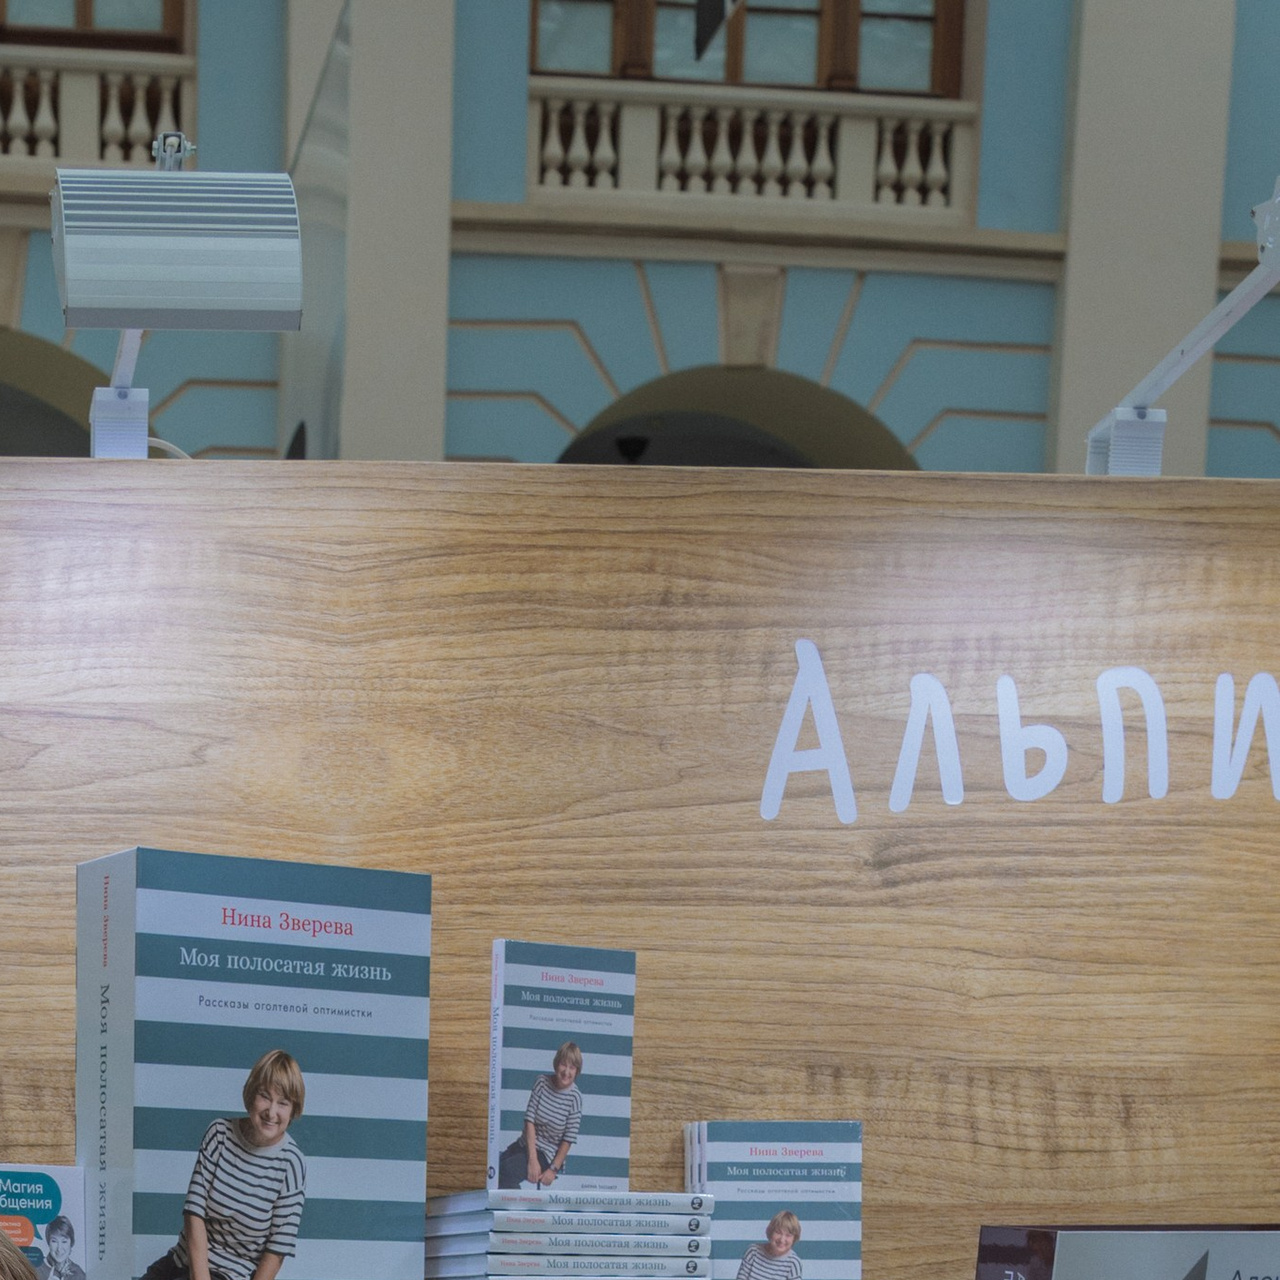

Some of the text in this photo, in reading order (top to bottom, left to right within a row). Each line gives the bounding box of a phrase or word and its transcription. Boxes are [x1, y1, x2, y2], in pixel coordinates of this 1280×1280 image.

[221, 906, 354, 938] Нина Зверева
[179, 946, 393, 981] Моя полосатая жизнь
[540, 971, 605, 988] Нина Зверева
[197, 994, 373, 1019] Рассказы оголтелой оптимистки
[519, 990, 623, 1010] Моя полосатая жизнь
[97, 982, 111, 1262] Моя полосатая жизнь
[749, 1147, 824, 1159] Нина Зверева
[726, 1166, 749, 1176] Моя
[752, 1166, 808, 1177] полосатая
[548, 1194, 671, 1208] Моя полосатая жизнь
